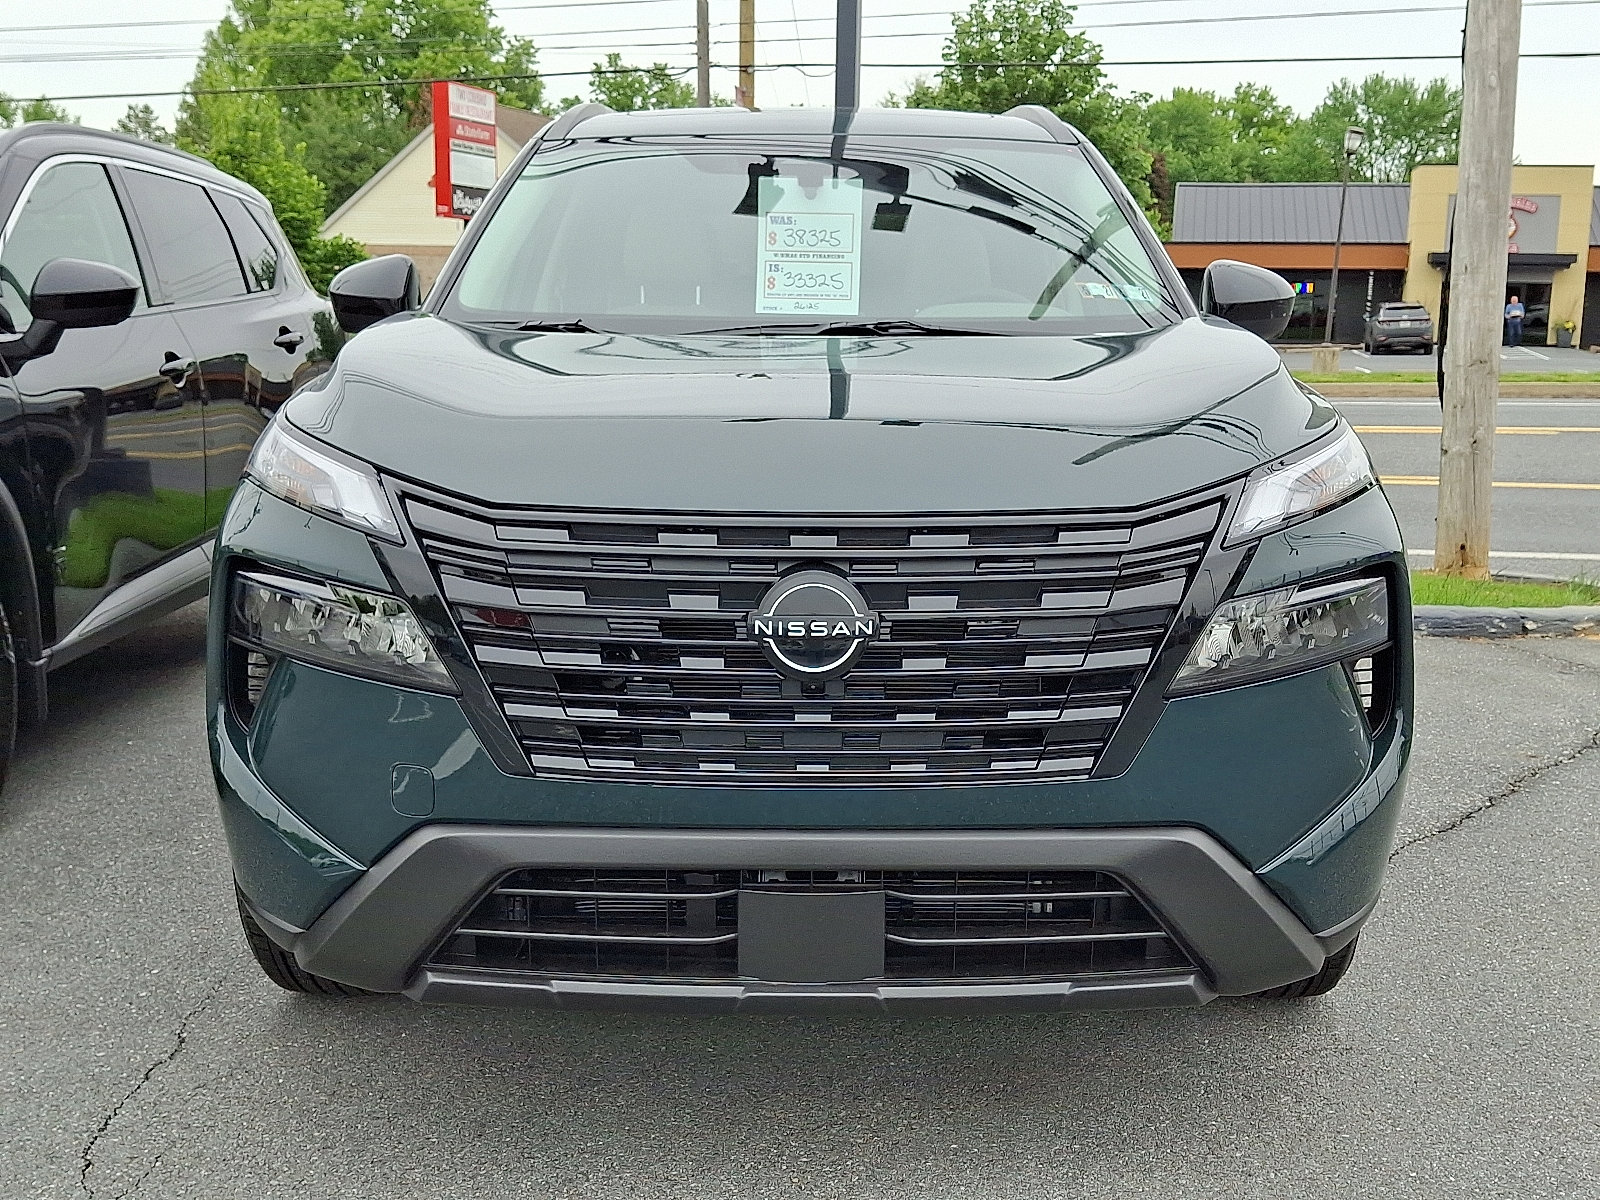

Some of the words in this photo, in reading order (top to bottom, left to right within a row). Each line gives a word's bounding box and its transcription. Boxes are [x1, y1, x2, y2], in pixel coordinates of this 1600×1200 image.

[769, 216, 797, 225] WAS:
[783, 228, 841, 248] 38325
[768, 263, 784, 273] IS:
[783, 272, 844, 290] 33325
[754, 620, 873, 637] NISSAN
